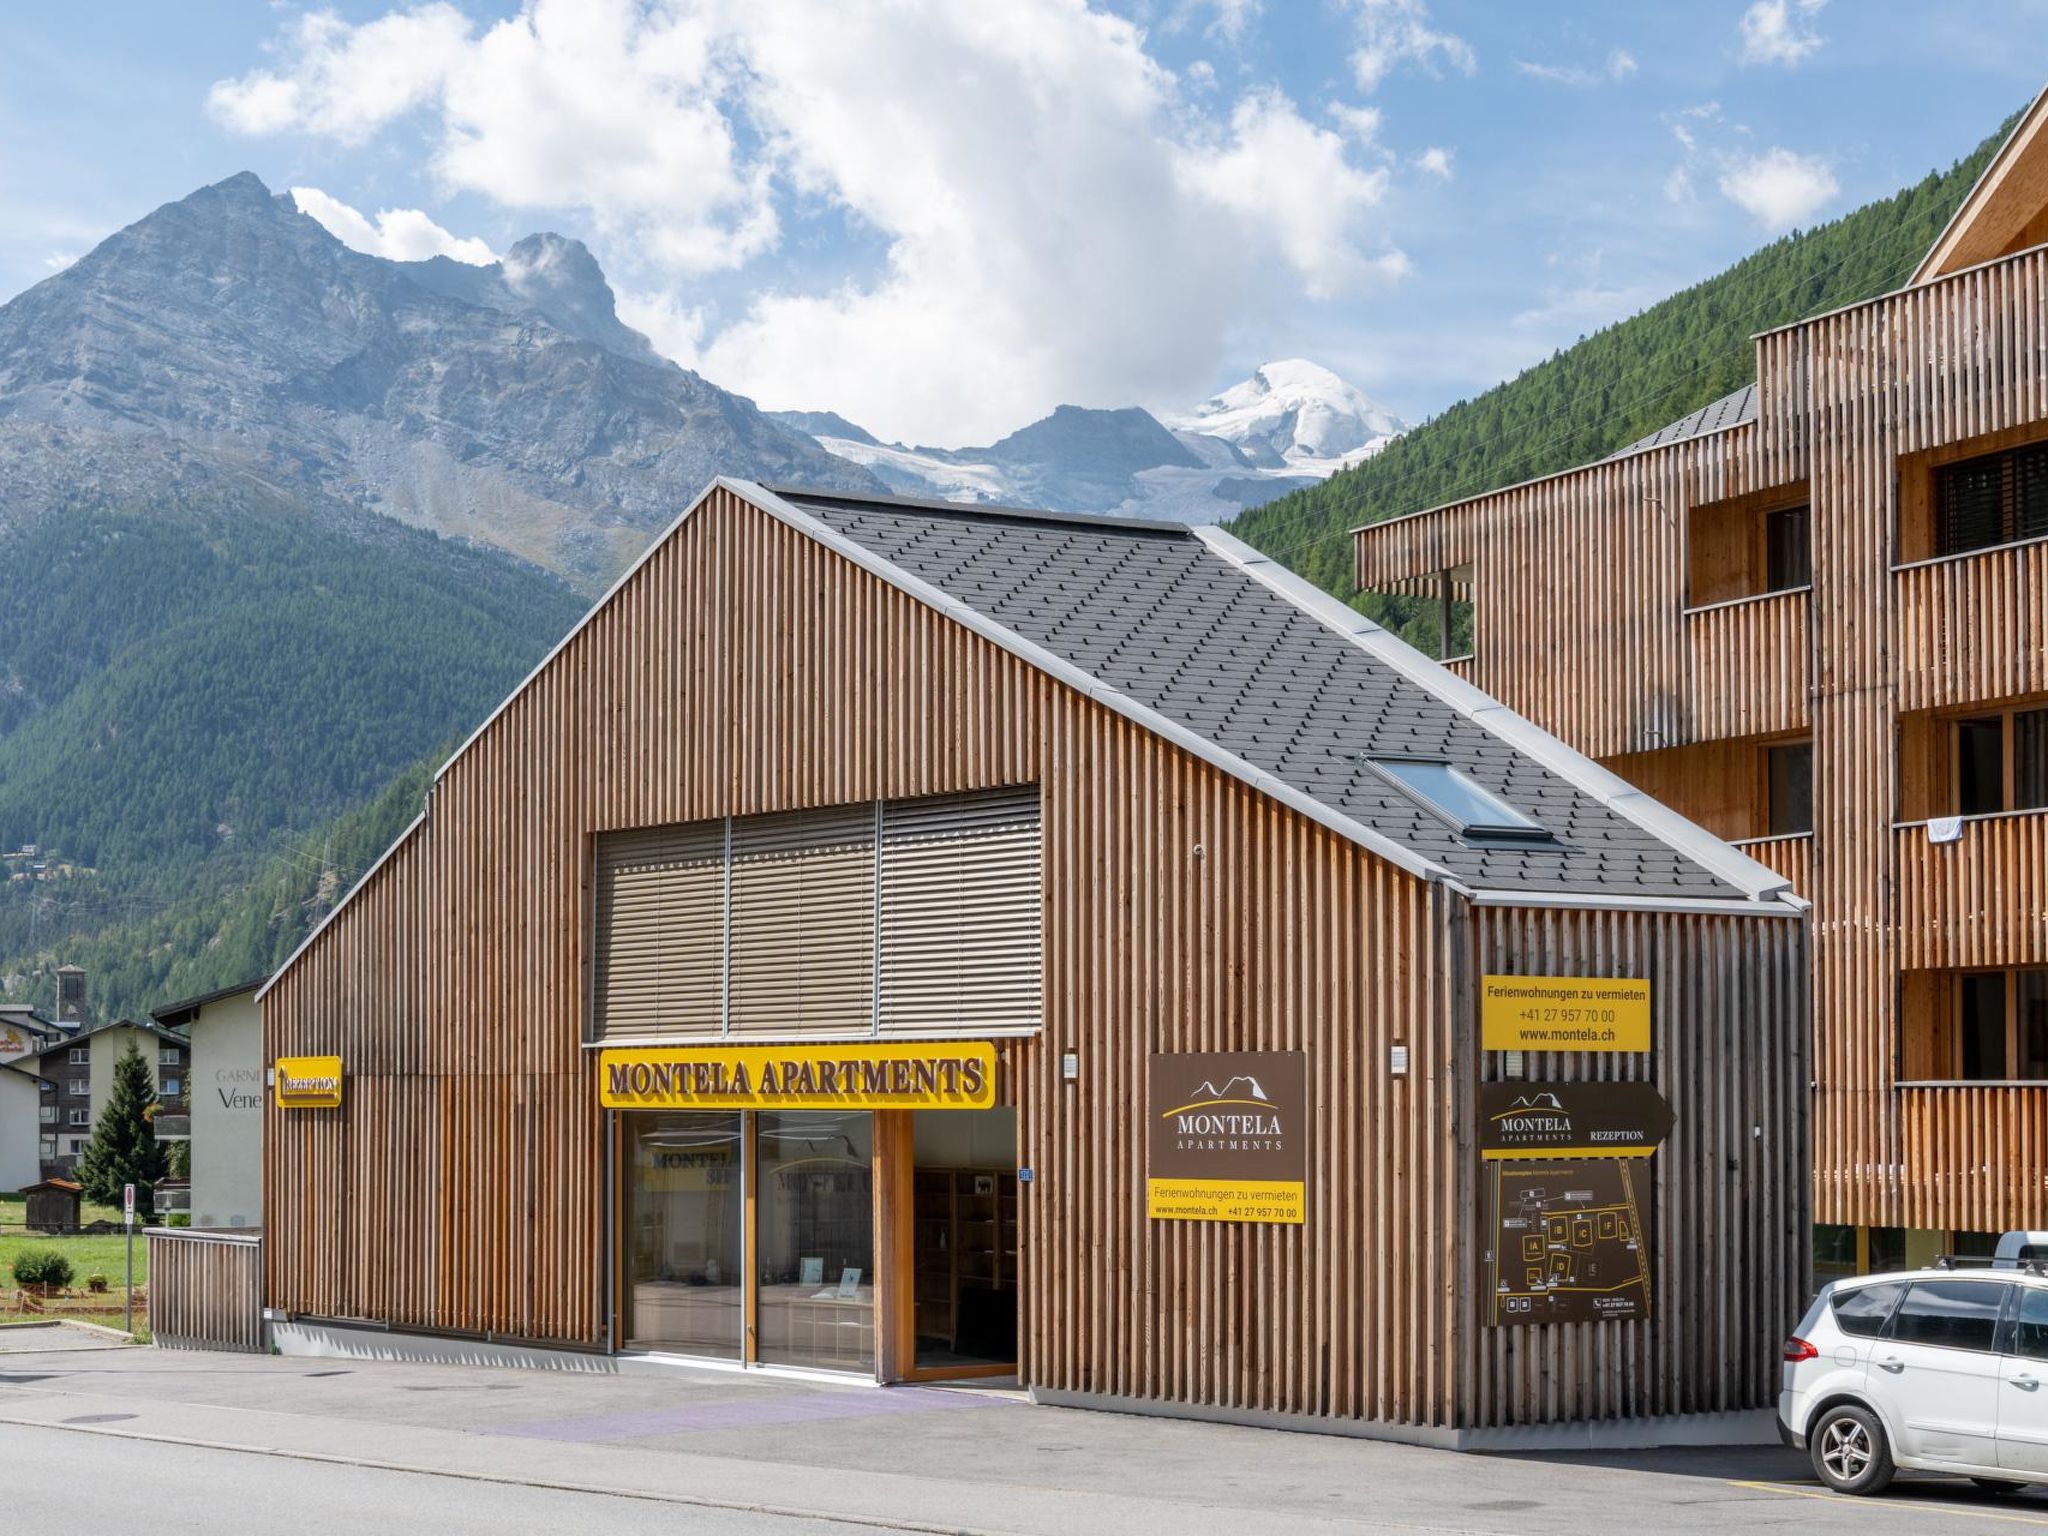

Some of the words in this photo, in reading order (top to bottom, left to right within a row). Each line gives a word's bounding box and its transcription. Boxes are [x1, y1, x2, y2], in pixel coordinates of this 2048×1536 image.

[1487, 985, 1578, 1001] Ferienwohnungen
[1581, 990, 1593, 1000] zu
[1595, 988, 1646, 1001] vermieten
[1519, 1008, 1540, 1021] +41
[1544, 1008, 1557, 1022] 27
[1561, 1008, 1581, 1022] 957
[1585, 1009, 1598, 1023] 70
[1601, 1009, 1615, 1023] 00
[1519, 1027, 1615, 1041] www.montela.ch
[606, 1061, 752, 1096] MONTELA
[757, 1057, 984, 1096] APARTMENTS
[1177, 1115, 1282, 1135] MONTELA
[1501, 1118, 1572, 1132] MONTELA
[1501, 1133, 1572, 1142] APARTMENTS
[1590, 1130, 1644, 1141] REZEPTION
[1177, 1140, 1282, 1150] APARTMENTS
[1154, 1186, 1234, 1202] Ferienwohnungen
[1236, 1191, 1248, 1201] zu
[1251, 1190, 1298, 1201] vermieten
[1155, 1205, 1218, 1215] www.montela.ch
[1228, 1207, 1242, 1217] +41
[1245, 1207, 1255, 1217] 27
[1256, 1208, 1272, 1217] 957
[1273, 1208, 1284, 1218] 70
[1286, 1208, 1297, 1218] 00
